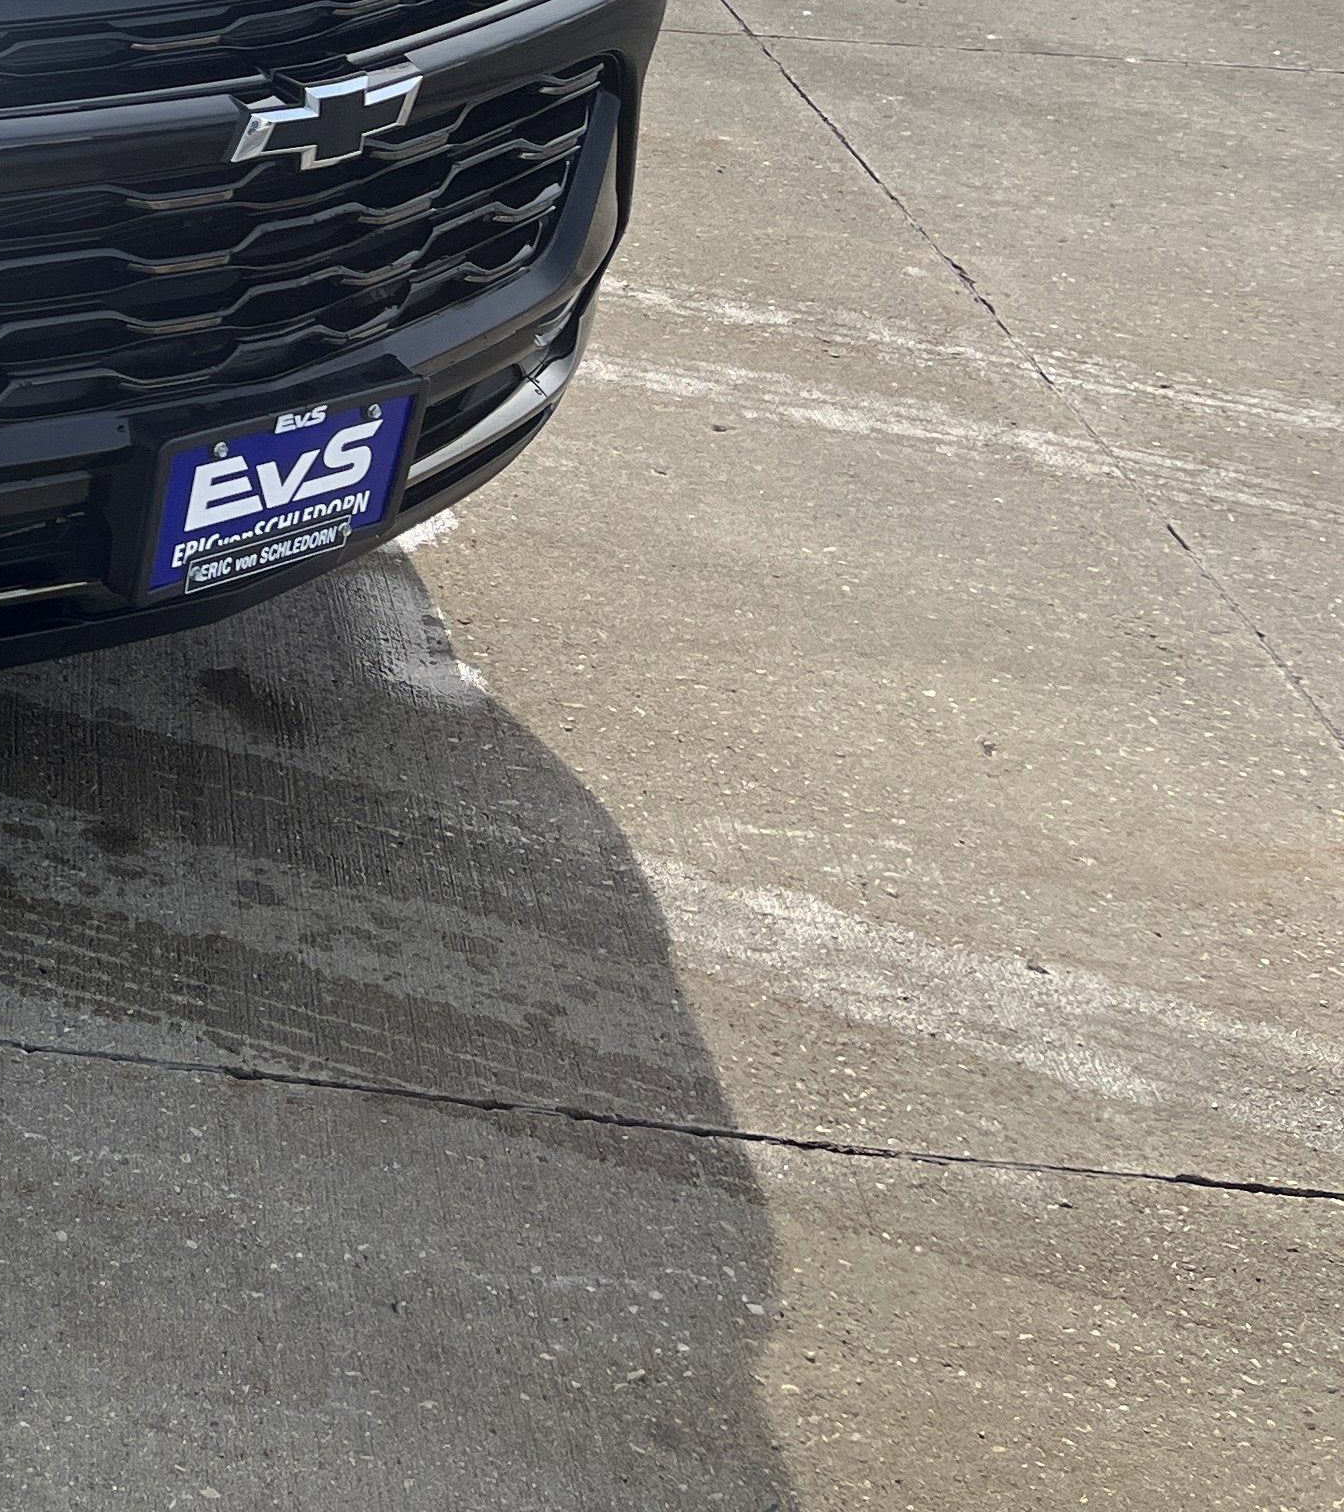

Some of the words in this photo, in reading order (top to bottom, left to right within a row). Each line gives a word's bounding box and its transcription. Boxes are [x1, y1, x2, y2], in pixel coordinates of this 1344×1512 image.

[274, 405, 328, 434] EvS
[184, 419, 384, 532] EvS
[195, 556, 233, 582] ERIC
[235, 553, 258, 571] von
[259, 525, 338, 564] SCHLEDORN
